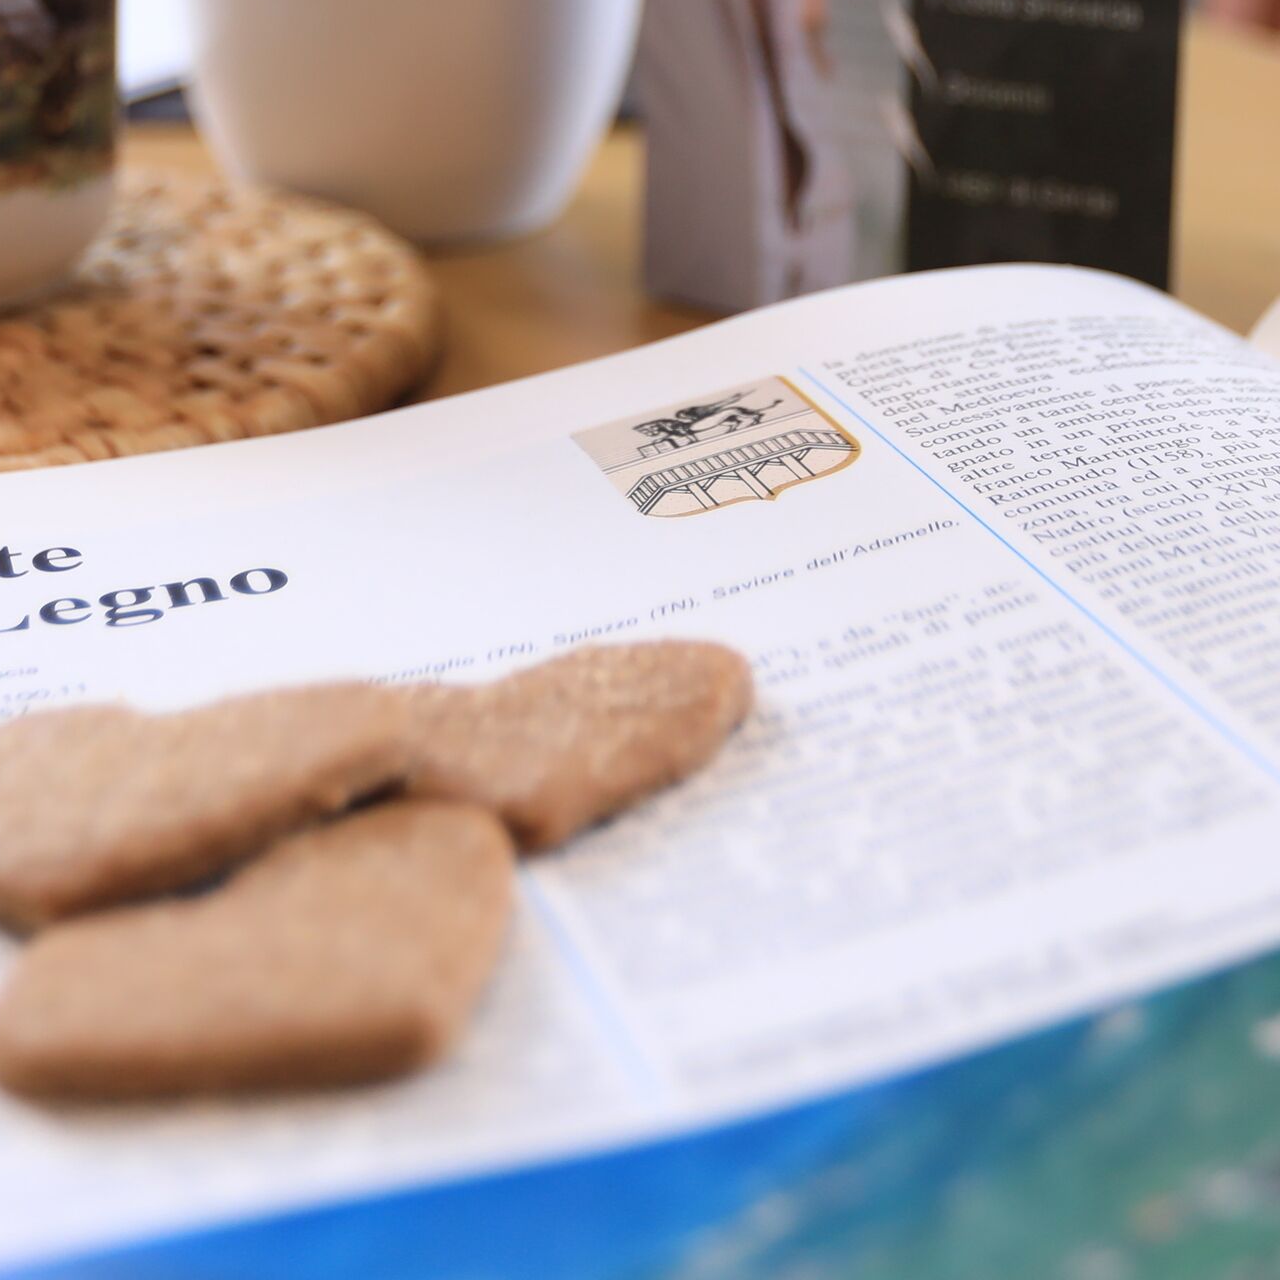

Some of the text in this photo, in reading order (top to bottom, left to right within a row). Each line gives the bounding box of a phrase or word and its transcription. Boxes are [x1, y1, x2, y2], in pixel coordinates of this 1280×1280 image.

[845, 354, 963, 389] Giselberto
[859, 377, 913, 401] pievi
[928, 368, 952, 381] di
[968, 348, 1063, 371] Cividate
[870, 369, 1002, 408] importante
[1016, 356, 1082, 375] anche
[881, 396, 938, 418] della
[953, 372, 1054, 399] struttura
[894, 383, 1062, 429] nel Medioevo.
[904, 389, 1097, 439] Successivamente
[1104, 382, 1123, 395] il
[919, 418, 1009, 450] comuni
[1017, 413, 1033, 425] a
[1036, 402, 1093, 420] tanti
[1100, 390, 1166, 409] centri
[932, 396, 1213, 461] tando un ambito feudo
[946, 446, 1016, 475] gnato
[1025, 436, 1052, 451] in
[1062, 429, 1095, 442] un
[1106, 414, 1178, 436] primo
[1186, 405, 1272, 420] tempo,
[960, 460, 1017, 483] altre
[1029, 443, 1089, 464] terre
[1098, 422, 1214, 448] limitrofe,
[1225, 417, 1241, 427] a
[972, 466, 1054, 496] franco
[1060, 434, 1202, 472] Martinengo
[1210, 429, 1242, 443] da
[986, 466, 1118, 506] Raimondo
[1126, 447, 1214, 470] (1158),
[1220, 439, 1261, 456] più
[1003, 480, 1122, 519] comunità
[1130, 470, 1162, 484] ed
[1172, 465, 1189, 476] a
[1017, 506, 1090, 533] zona,
[1094, 494, 1133, 510] tra
[1141, 482, 1182, 499] cui
[1031, 514, 1116, 545] Nadro
[1122, 490, 1212, 519] (secolo
[1153, 509, 1204, 527] uno
[1214, 498, 1255, 514] dei
[1064, 550, 1109, 575] più
[1118, 523, 1211, 556] delicati
[1218, 507, 1280, 529] della
[1081, 556, 1155, 585] vanni
[1156, 534, 1237, 563] Maria
[1099, 582, 1124, 599] al
[1130, 564, 1196, 589] ricco
[1160, 561, 1270, 598] signorili
[552, 616, 639, 646] Spiazzo
[711, 568, 796, 600] Saviore
